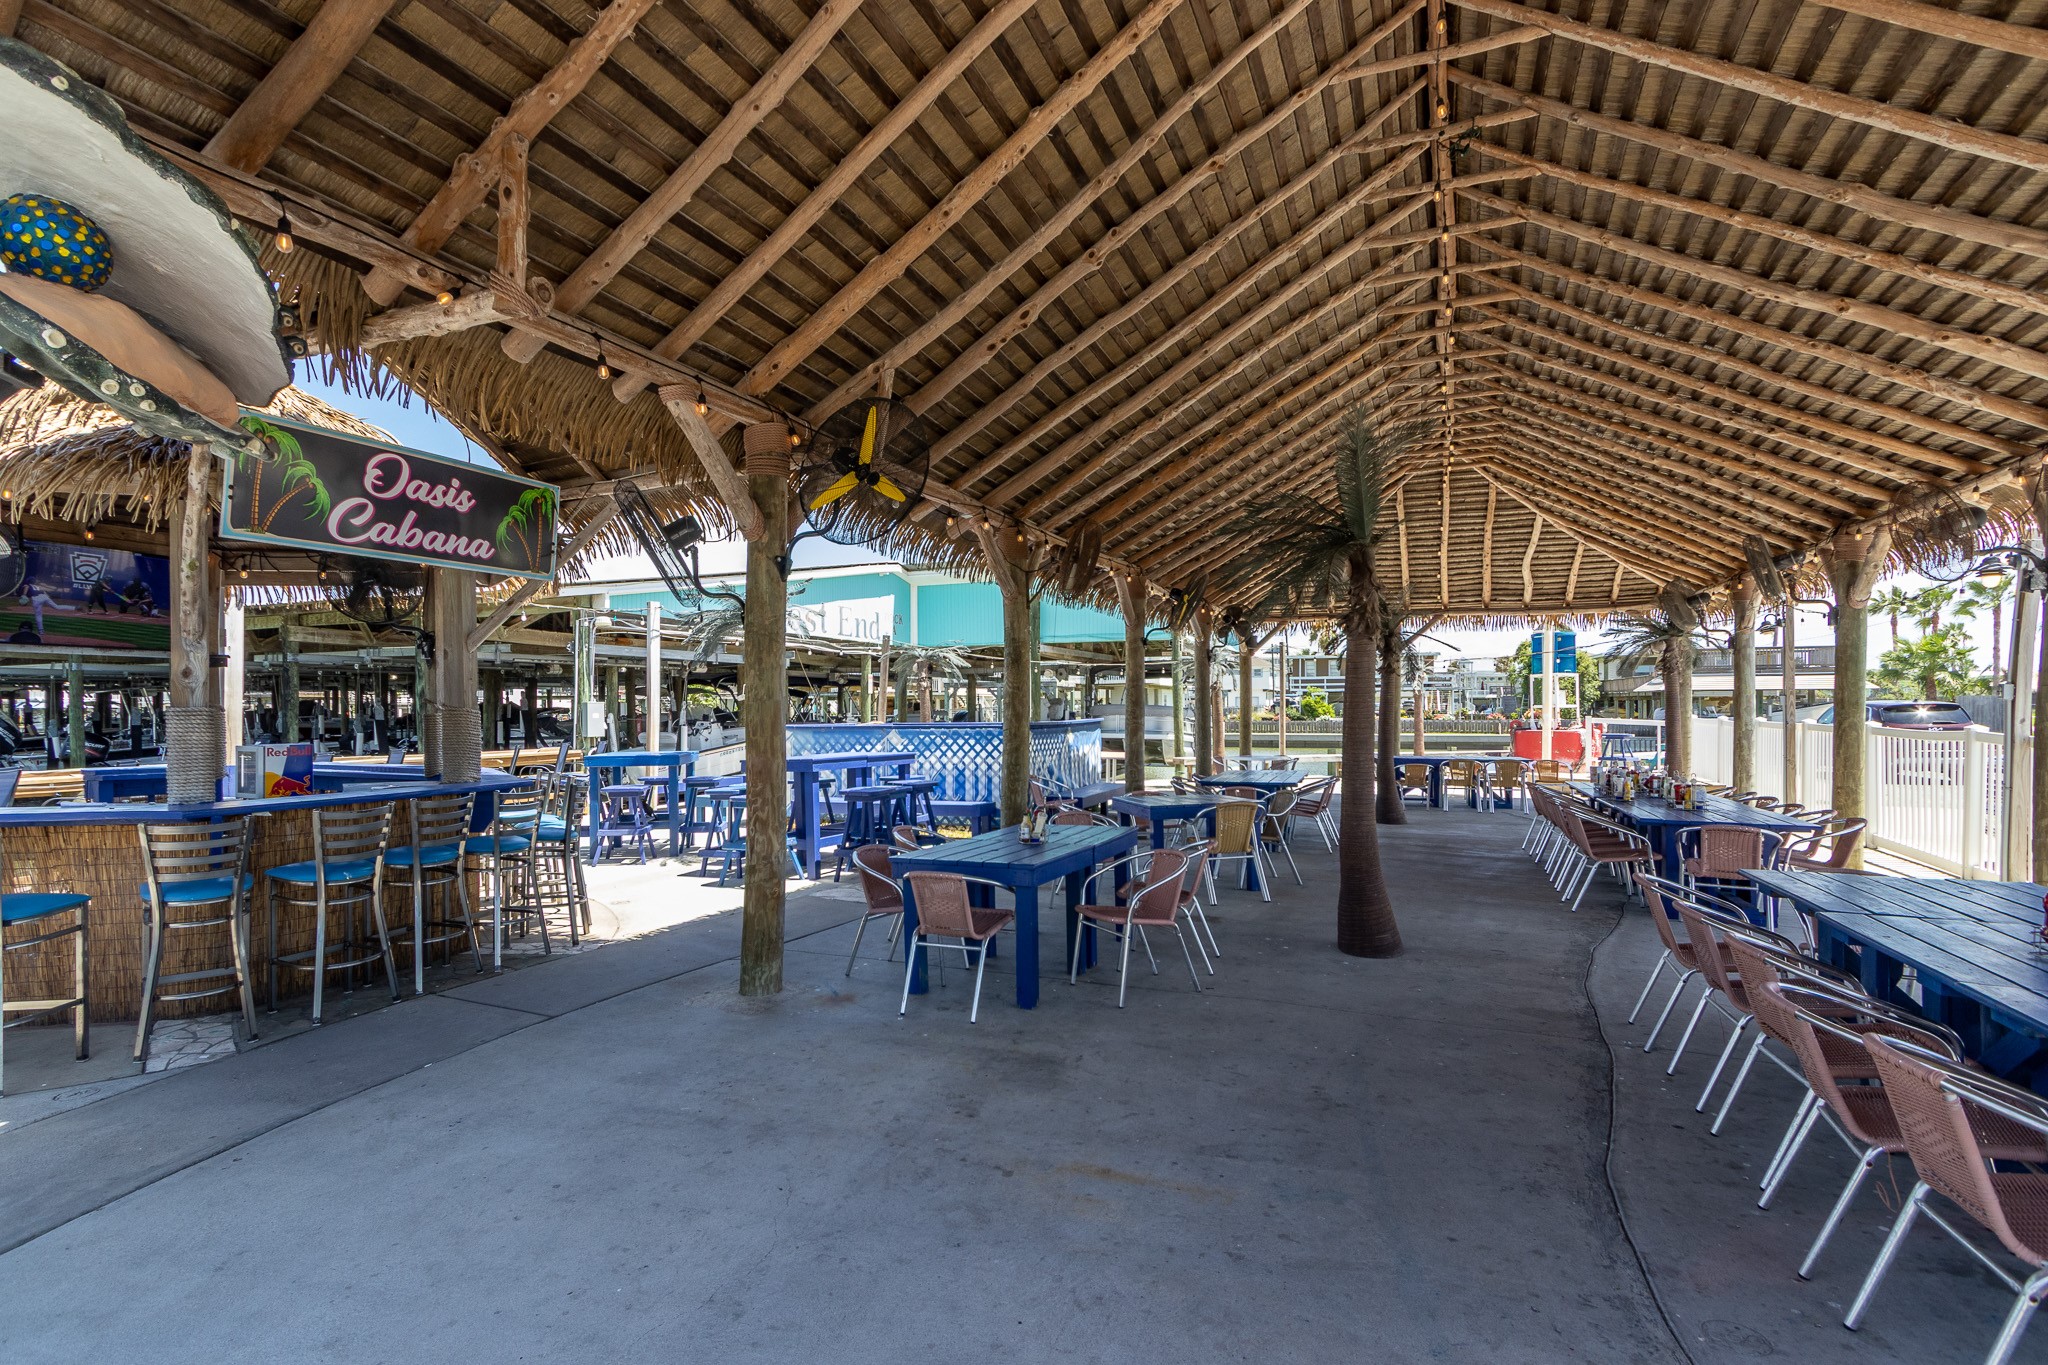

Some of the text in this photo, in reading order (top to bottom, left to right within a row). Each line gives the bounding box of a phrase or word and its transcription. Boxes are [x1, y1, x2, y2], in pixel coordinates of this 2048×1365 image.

[364, 453, 476, 512] Oasis
[327, 497, 496, 558] Cabana
[786, 606, 880, 640] est End
[266, 746, 312, 756] Red Bull
